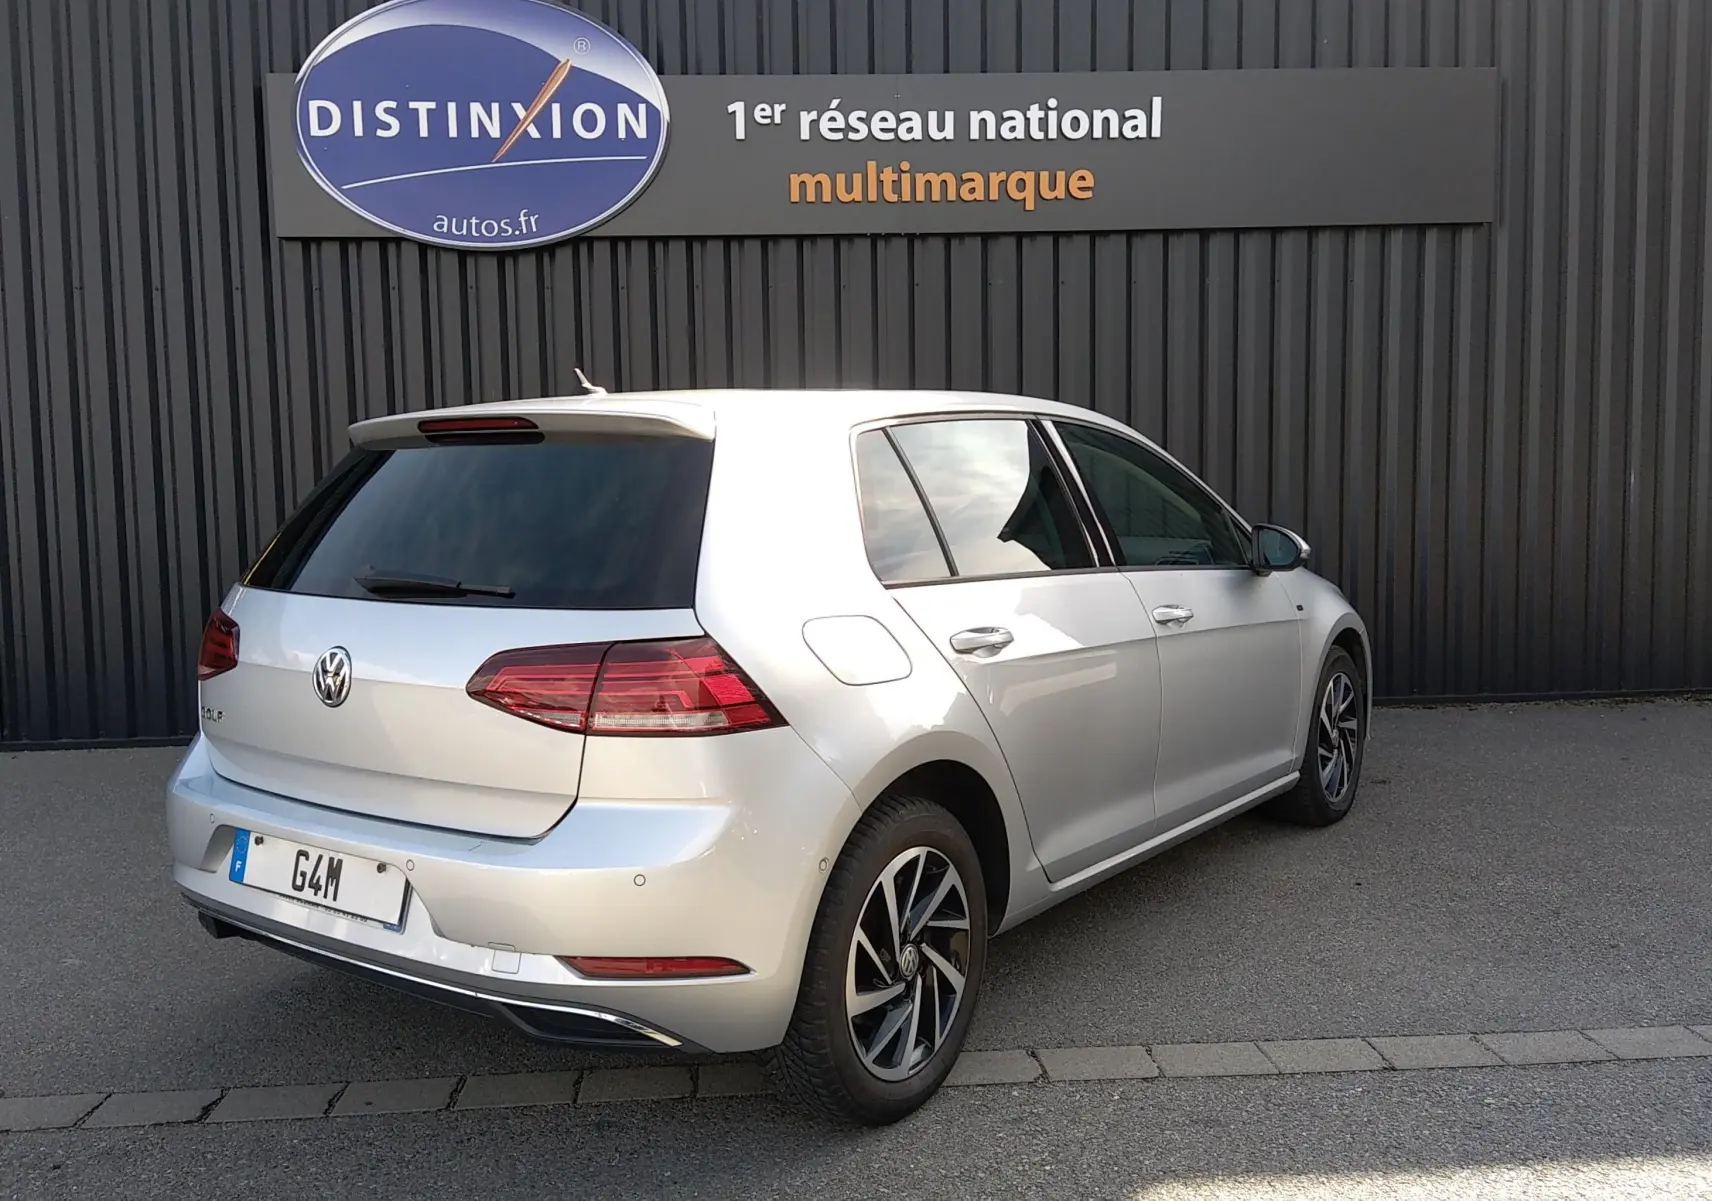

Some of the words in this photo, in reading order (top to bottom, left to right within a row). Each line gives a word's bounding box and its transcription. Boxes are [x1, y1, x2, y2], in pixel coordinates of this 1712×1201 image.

[308, 99, 649, 140] DISTINXION
[800, 98, 955, 142] réseau
[969, 96, 1163, 142] national
[789, 160, 1095, 211] multimarque
[432, 208, 540, 238] autos.fr
[234, 860, 242, 873] F
[291, 849, 343, 902] G4M
